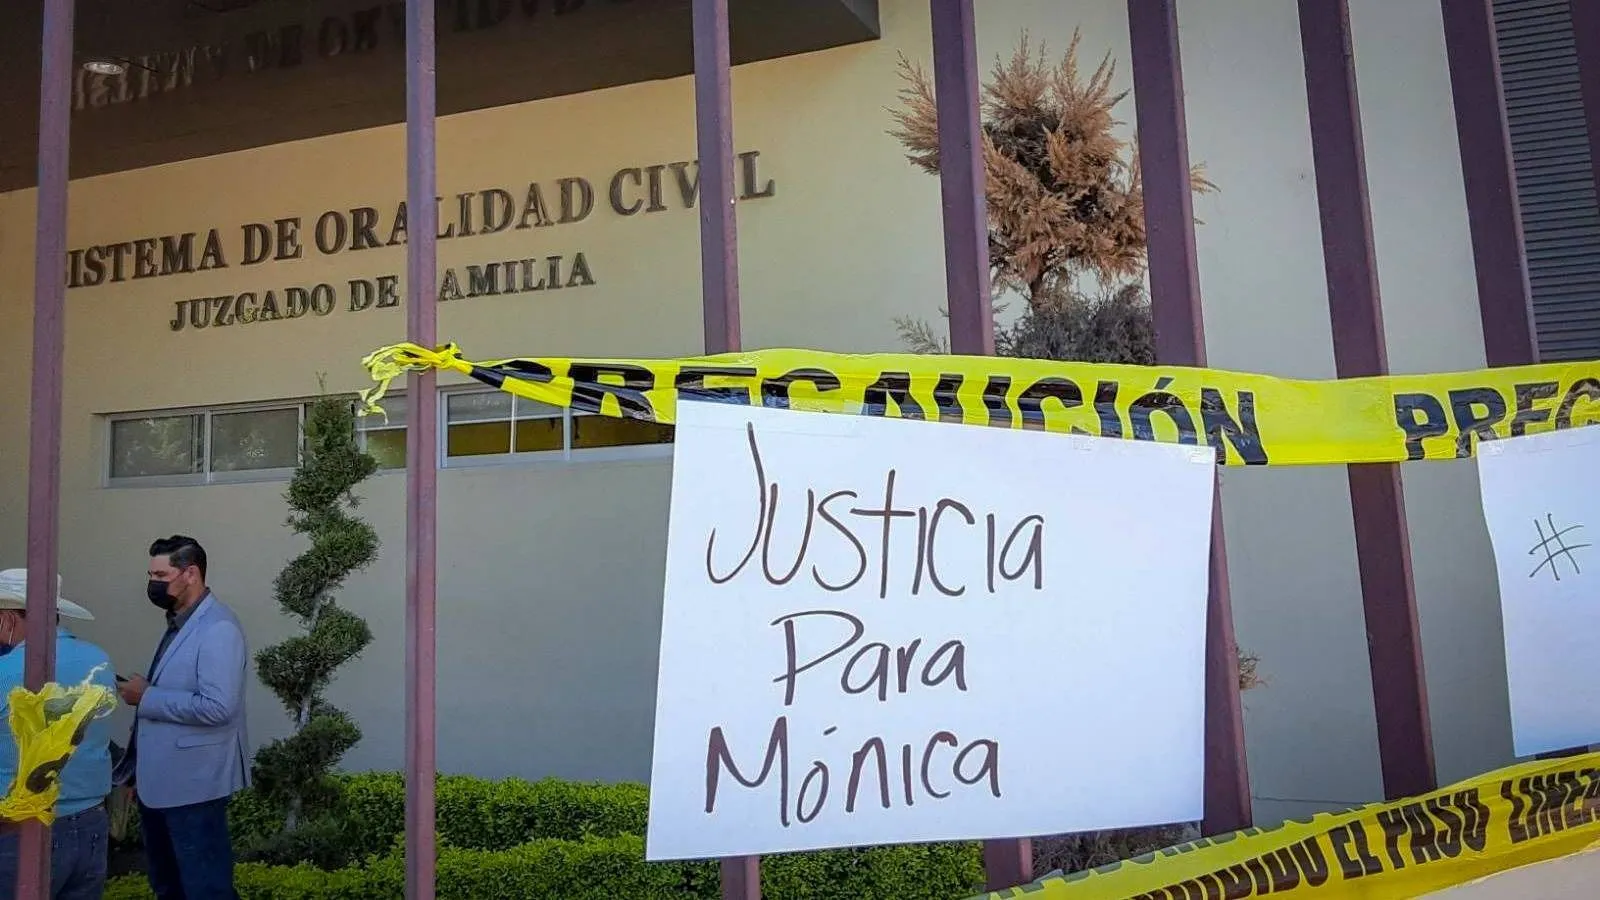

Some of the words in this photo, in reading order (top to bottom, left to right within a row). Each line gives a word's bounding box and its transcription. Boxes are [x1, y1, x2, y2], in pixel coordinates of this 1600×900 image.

[64, 228, 229, 289] ISTEMA
[240, 217, 303, 266] DE
[609, 150, 776, 216] CIVL
[169, 283, 337, 332] JUZGADO
[347, 274, 400, 313] DE
[437, 251, 597, 302] AMILIA
[706, 421, 1048, 599] Justicia
[770, 609, 968, 706] Para
[704, 715, 1002, 828] Mónica
[1328, 819, 1385, 880] EL
[1375, 787, 1491, 870] PASO
